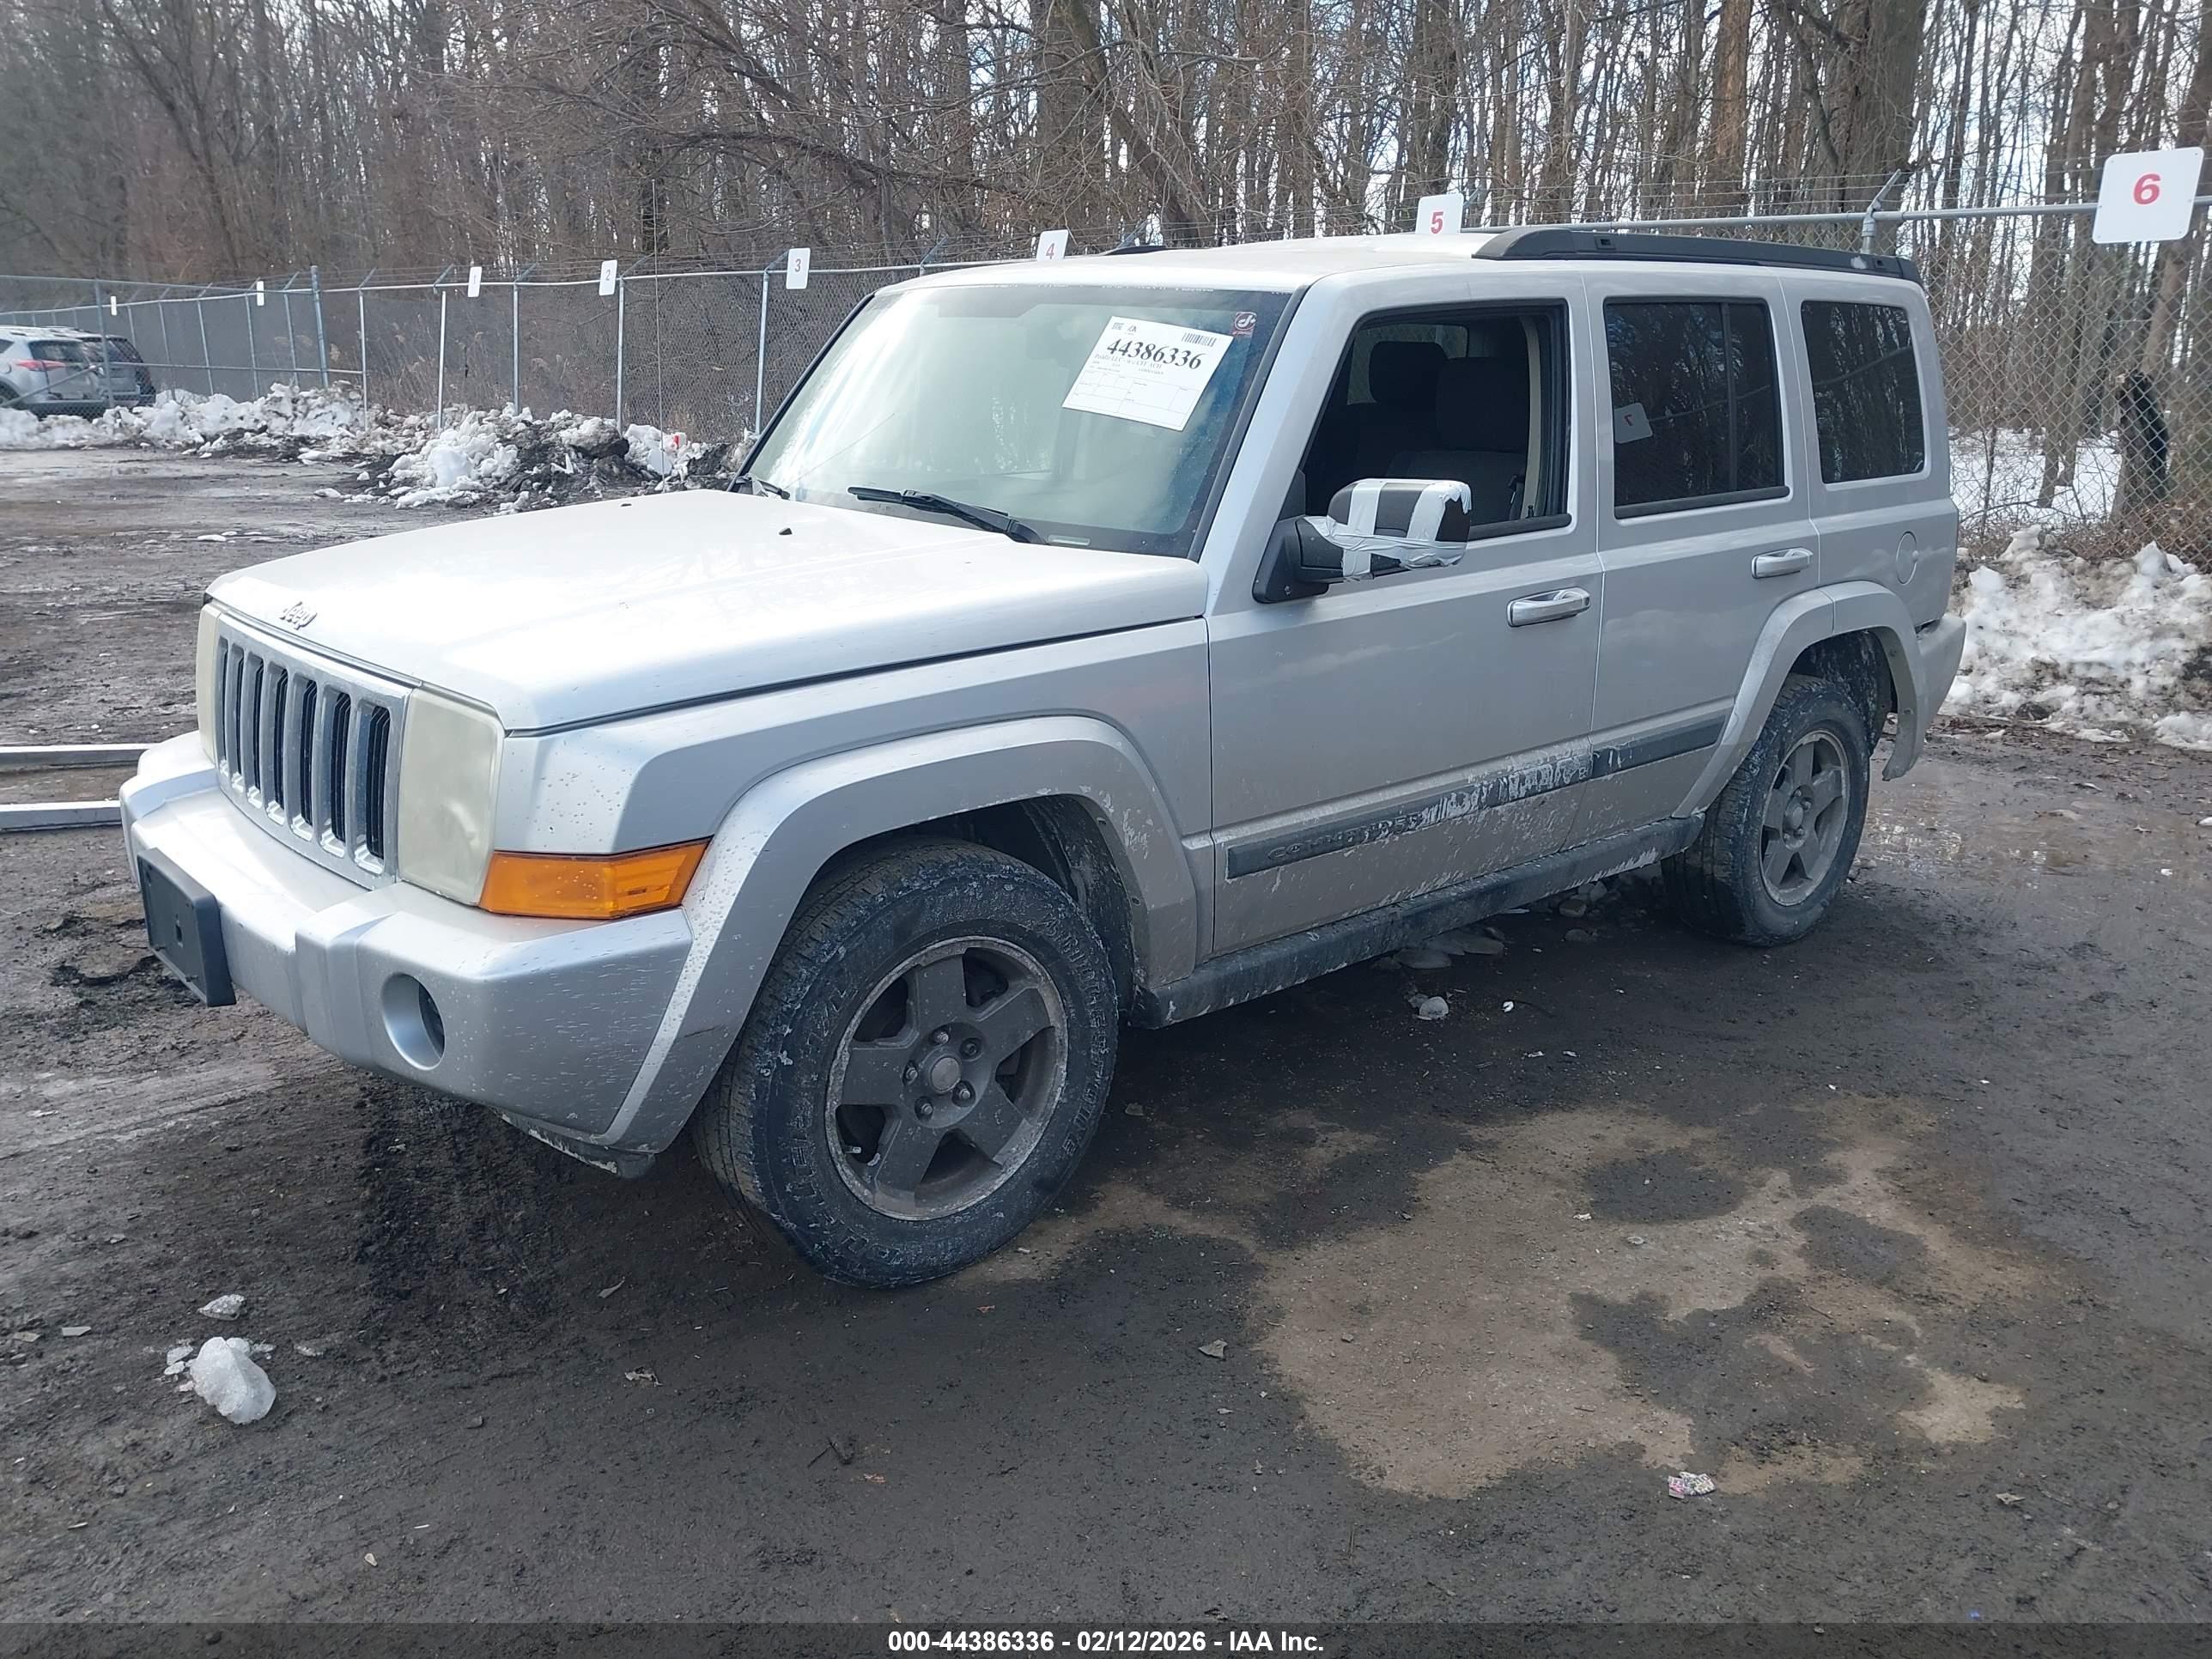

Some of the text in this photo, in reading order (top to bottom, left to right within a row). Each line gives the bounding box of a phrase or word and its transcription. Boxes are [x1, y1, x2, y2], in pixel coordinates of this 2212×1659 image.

[2133, 173, 2161, 205] 6
[1431, 211, 1444, 234] 5
[1045, 242, 1055, 260] 4
[605, 269, 611, 282] 2
[794, 258, 802, 273] 3
[1106, 337, 1209, 370] 44386336
[278, 600, 318, 631] Jeep
